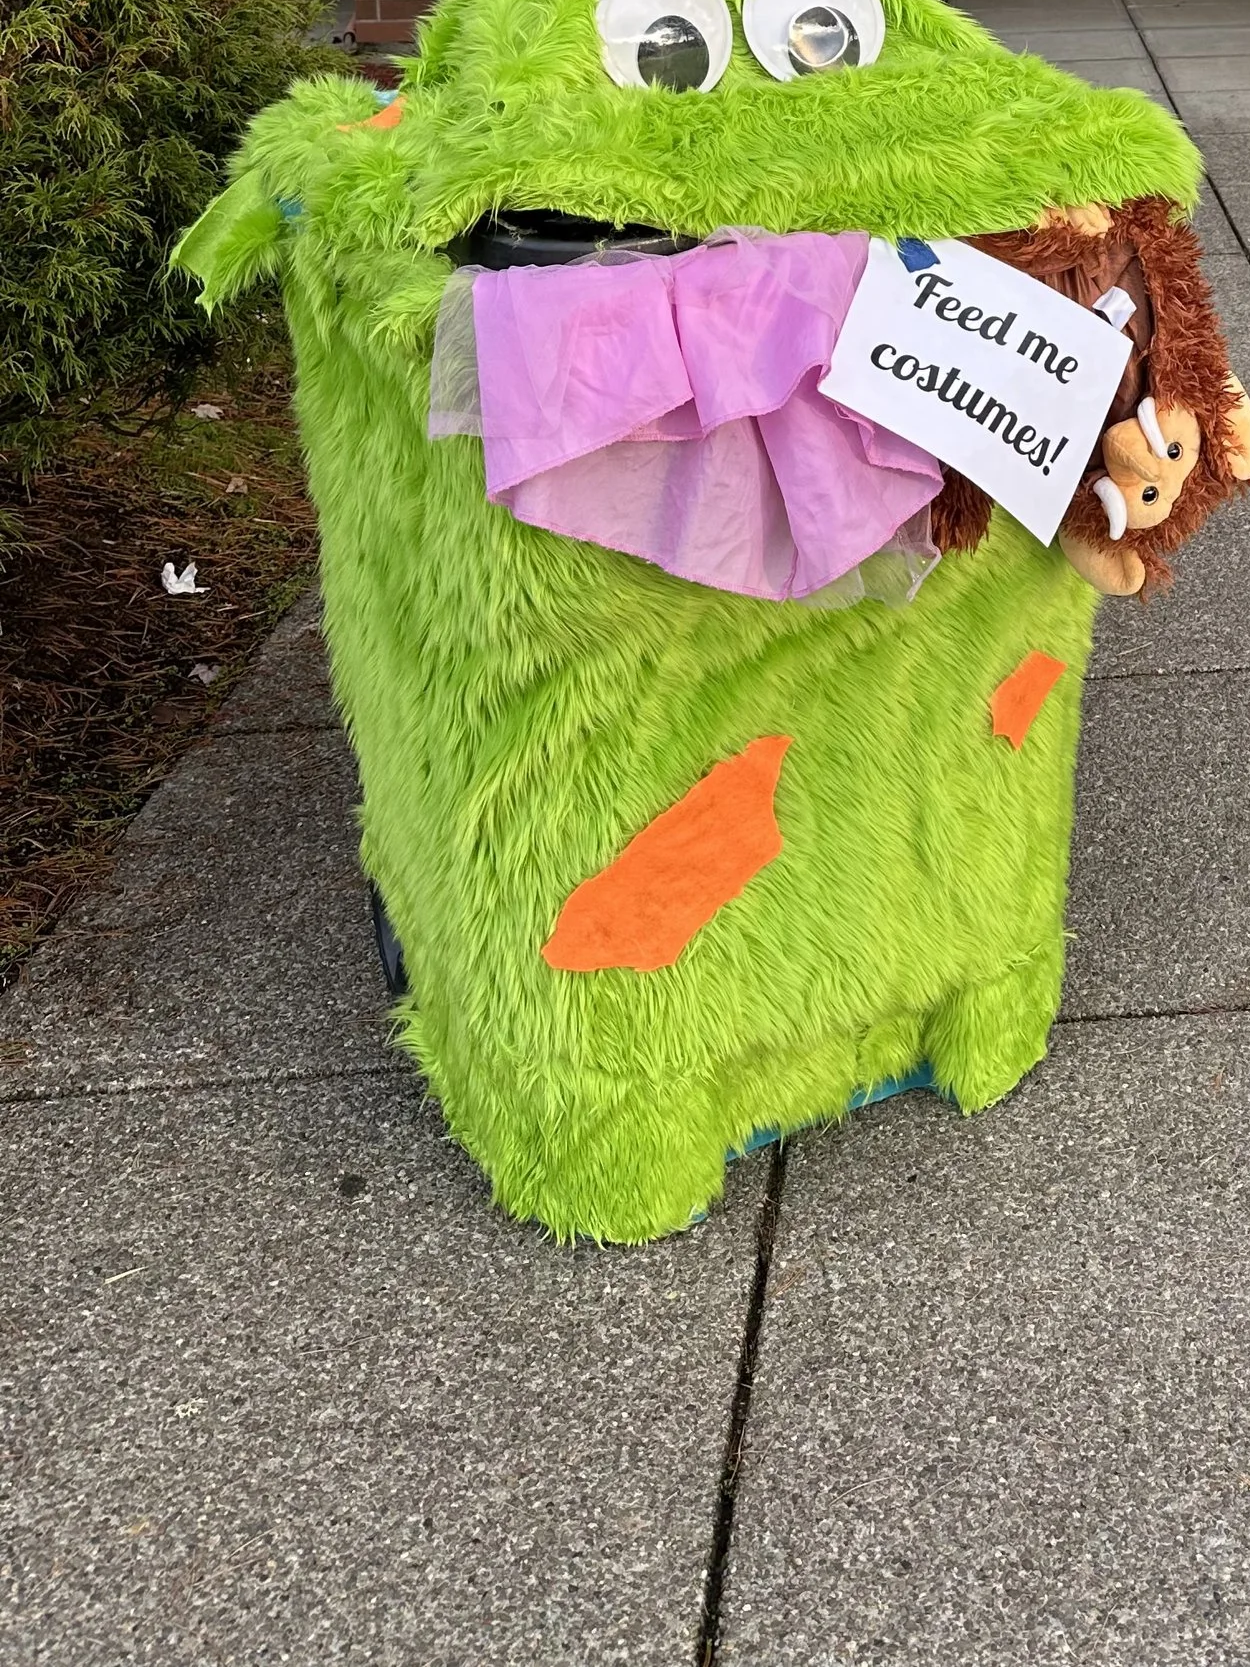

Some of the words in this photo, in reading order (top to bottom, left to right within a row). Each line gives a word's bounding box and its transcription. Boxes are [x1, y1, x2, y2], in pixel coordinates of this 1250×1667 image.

[914, 272, 1018, 346] Feed
[1016, 330, 1079, 384] me
[870, 343, 1070, 476] costumes!
